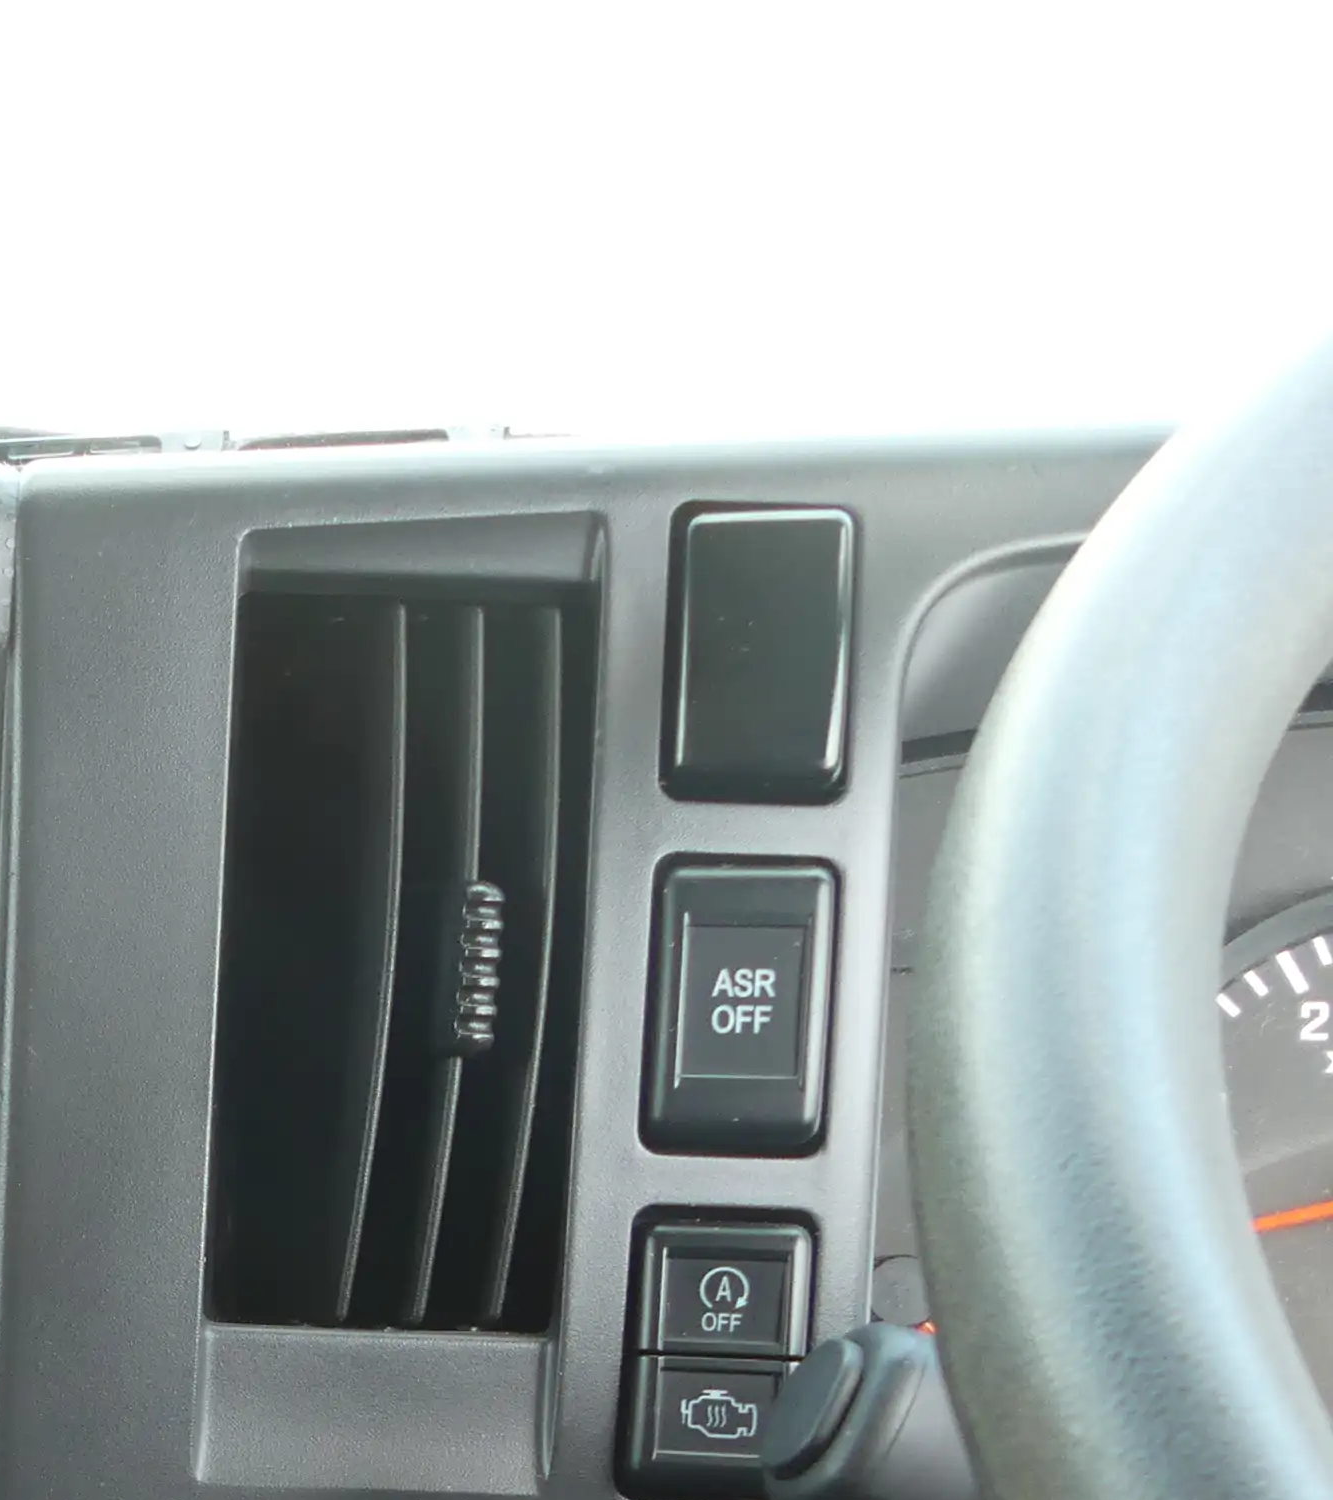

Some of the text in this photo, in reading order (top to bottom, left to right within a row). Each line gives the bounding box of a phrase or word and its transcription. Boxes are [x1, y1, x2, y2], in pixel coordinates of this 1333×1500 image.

[711, 968, 776, 999] ASR
[711, 1004, 773, 1034] OFF
[701, 1312, 742, 1332] OFF
